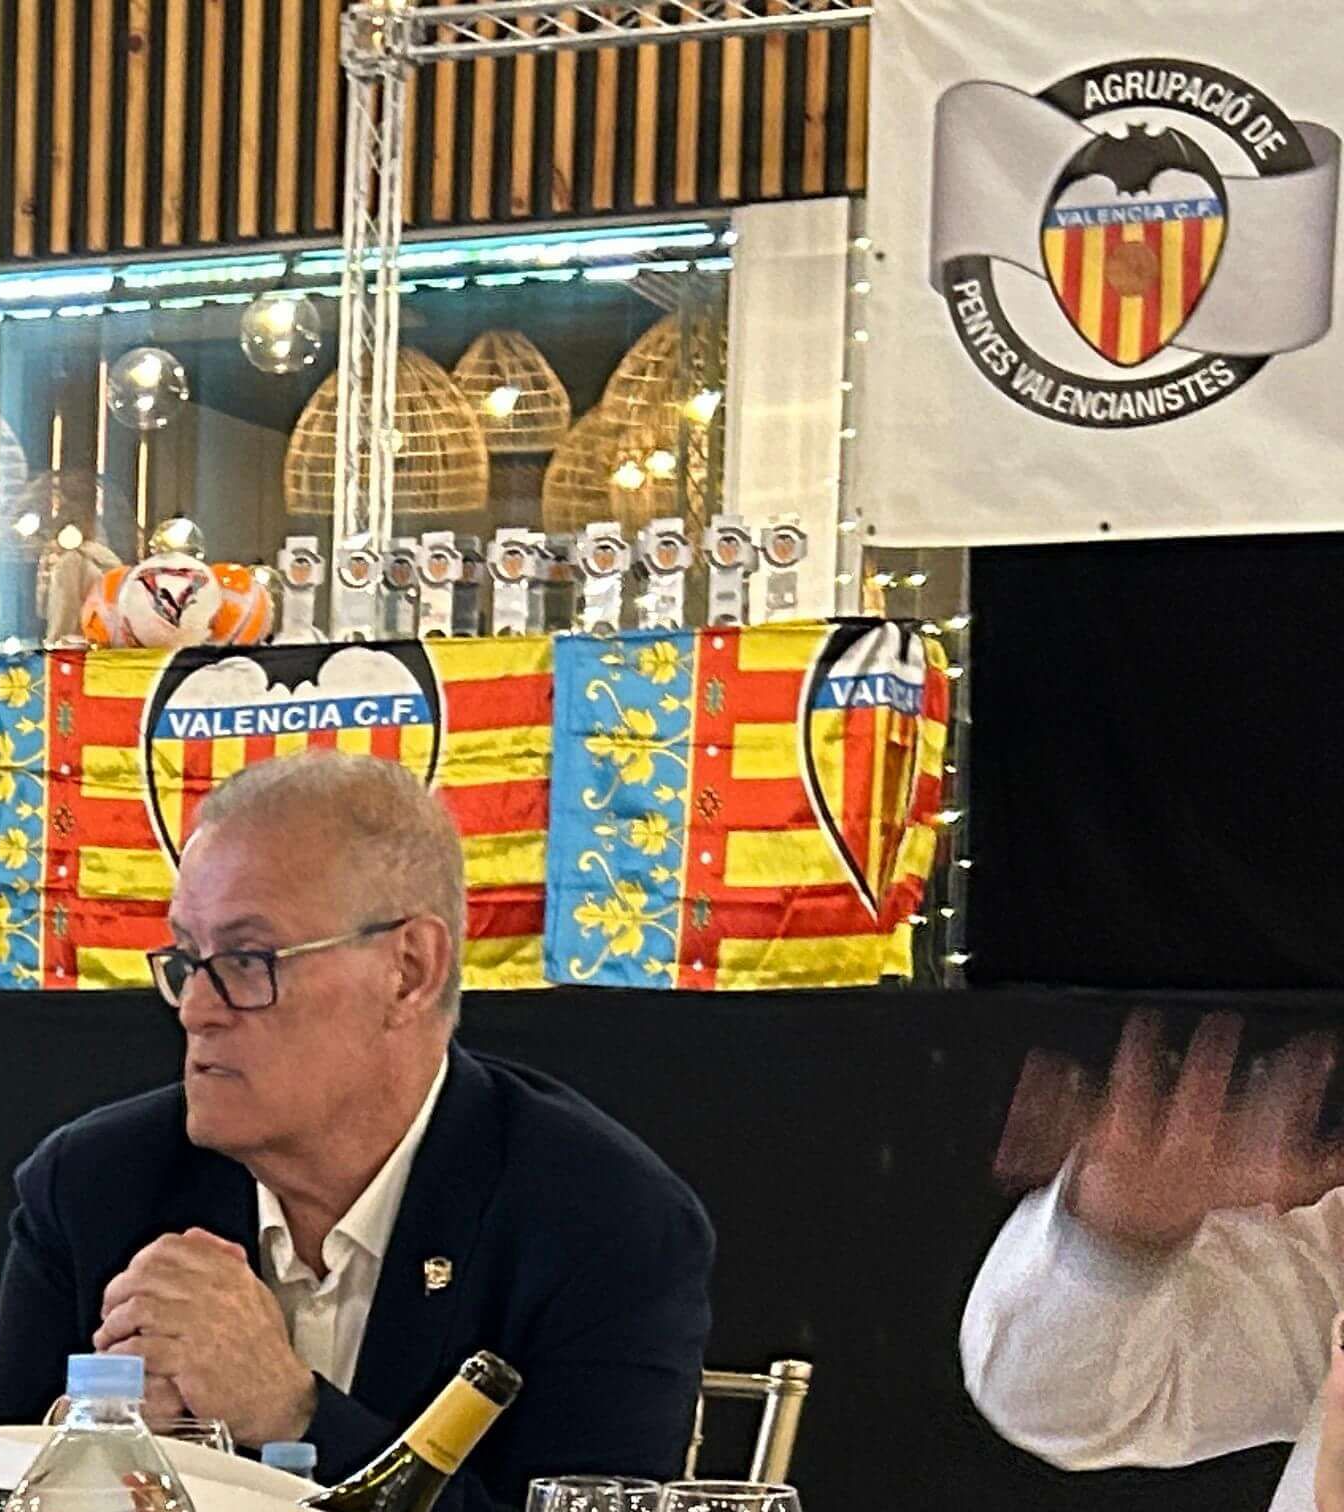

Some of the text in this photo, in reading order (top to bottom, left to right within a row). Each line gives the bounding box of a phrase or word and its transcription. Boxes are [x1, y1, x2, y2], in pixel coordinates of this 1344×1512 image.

[1083, 70, 1289, 162] AGRUPACIÓ DE
[1056, 203, 1166, 228] VALENCIA
[952, 279, 1235, 421] PENYES VALENCIANISTES
[168, 698, 419, 738] VALENCIA C.F.
